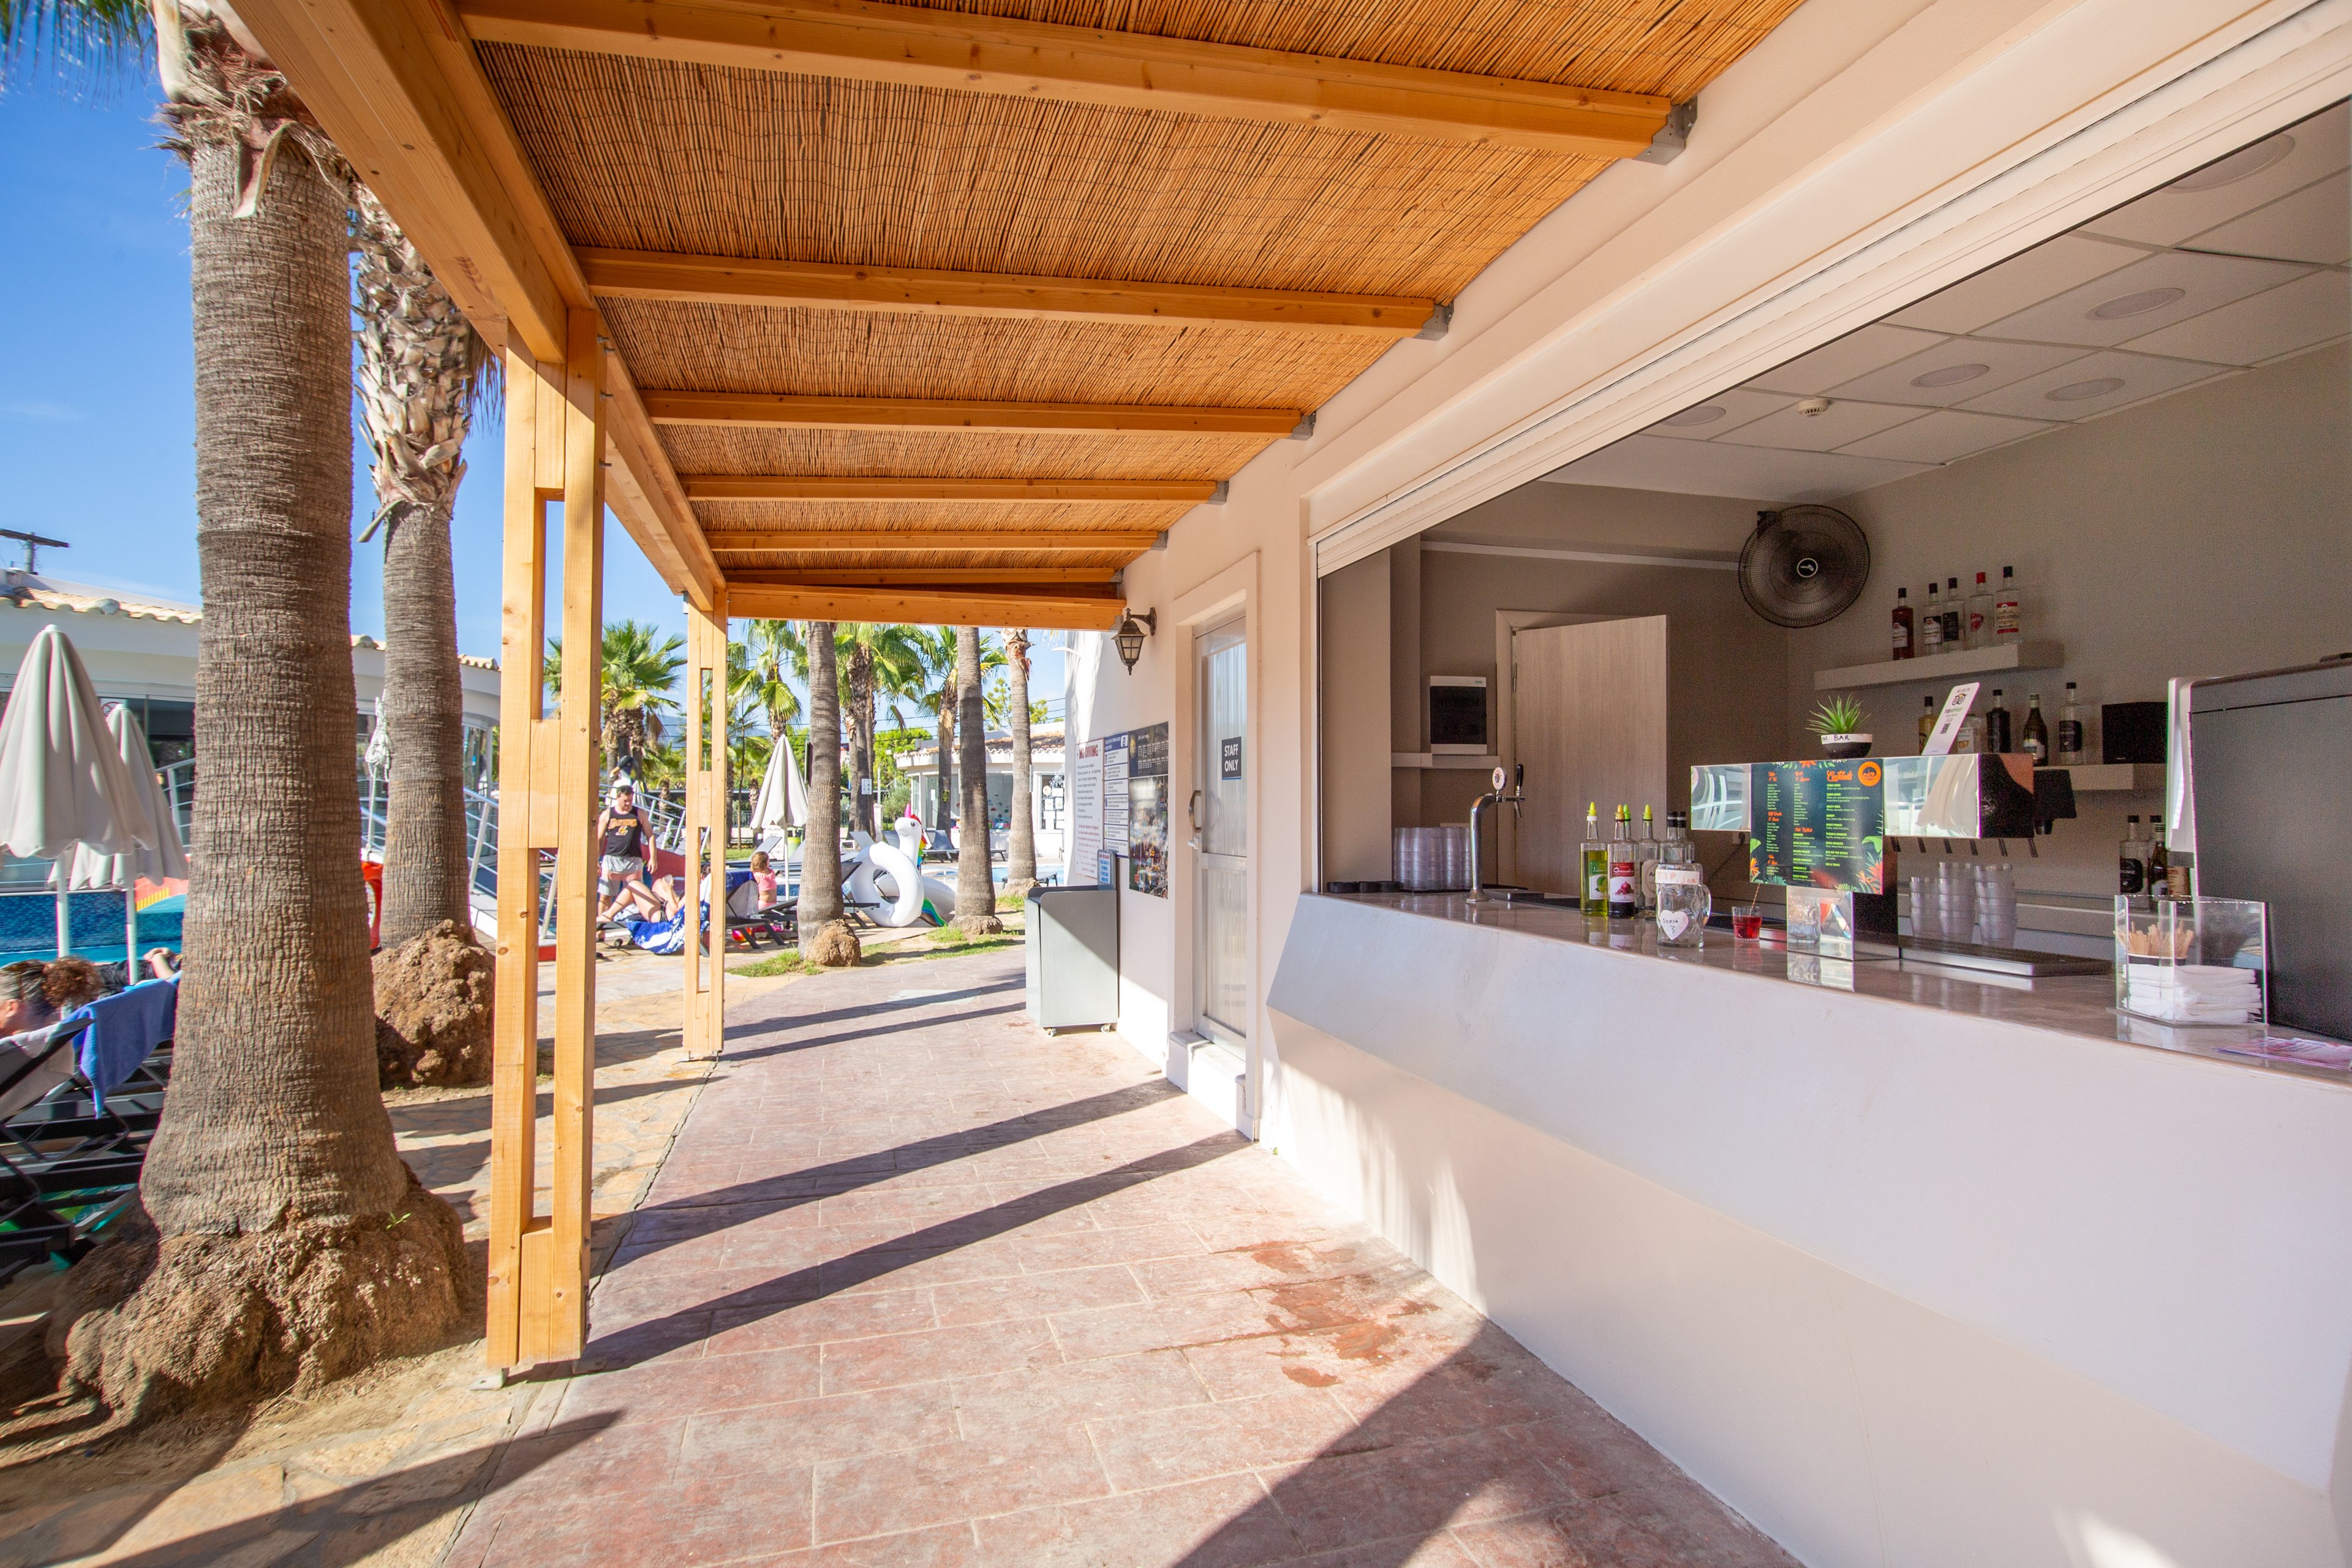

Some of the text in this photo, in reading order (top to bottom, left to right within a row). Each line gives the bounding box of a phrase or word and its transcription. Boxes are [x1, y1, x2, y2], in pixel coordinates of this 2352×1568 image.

[1079, 748, 1084, 760] NO
[1085, 745, 1098, 758] DIVING
[1224, 744, 1238, 757] STAFF
[1224, 760, 1238, 772] ONLY
[1657, 871, 1676, 880] TIP
